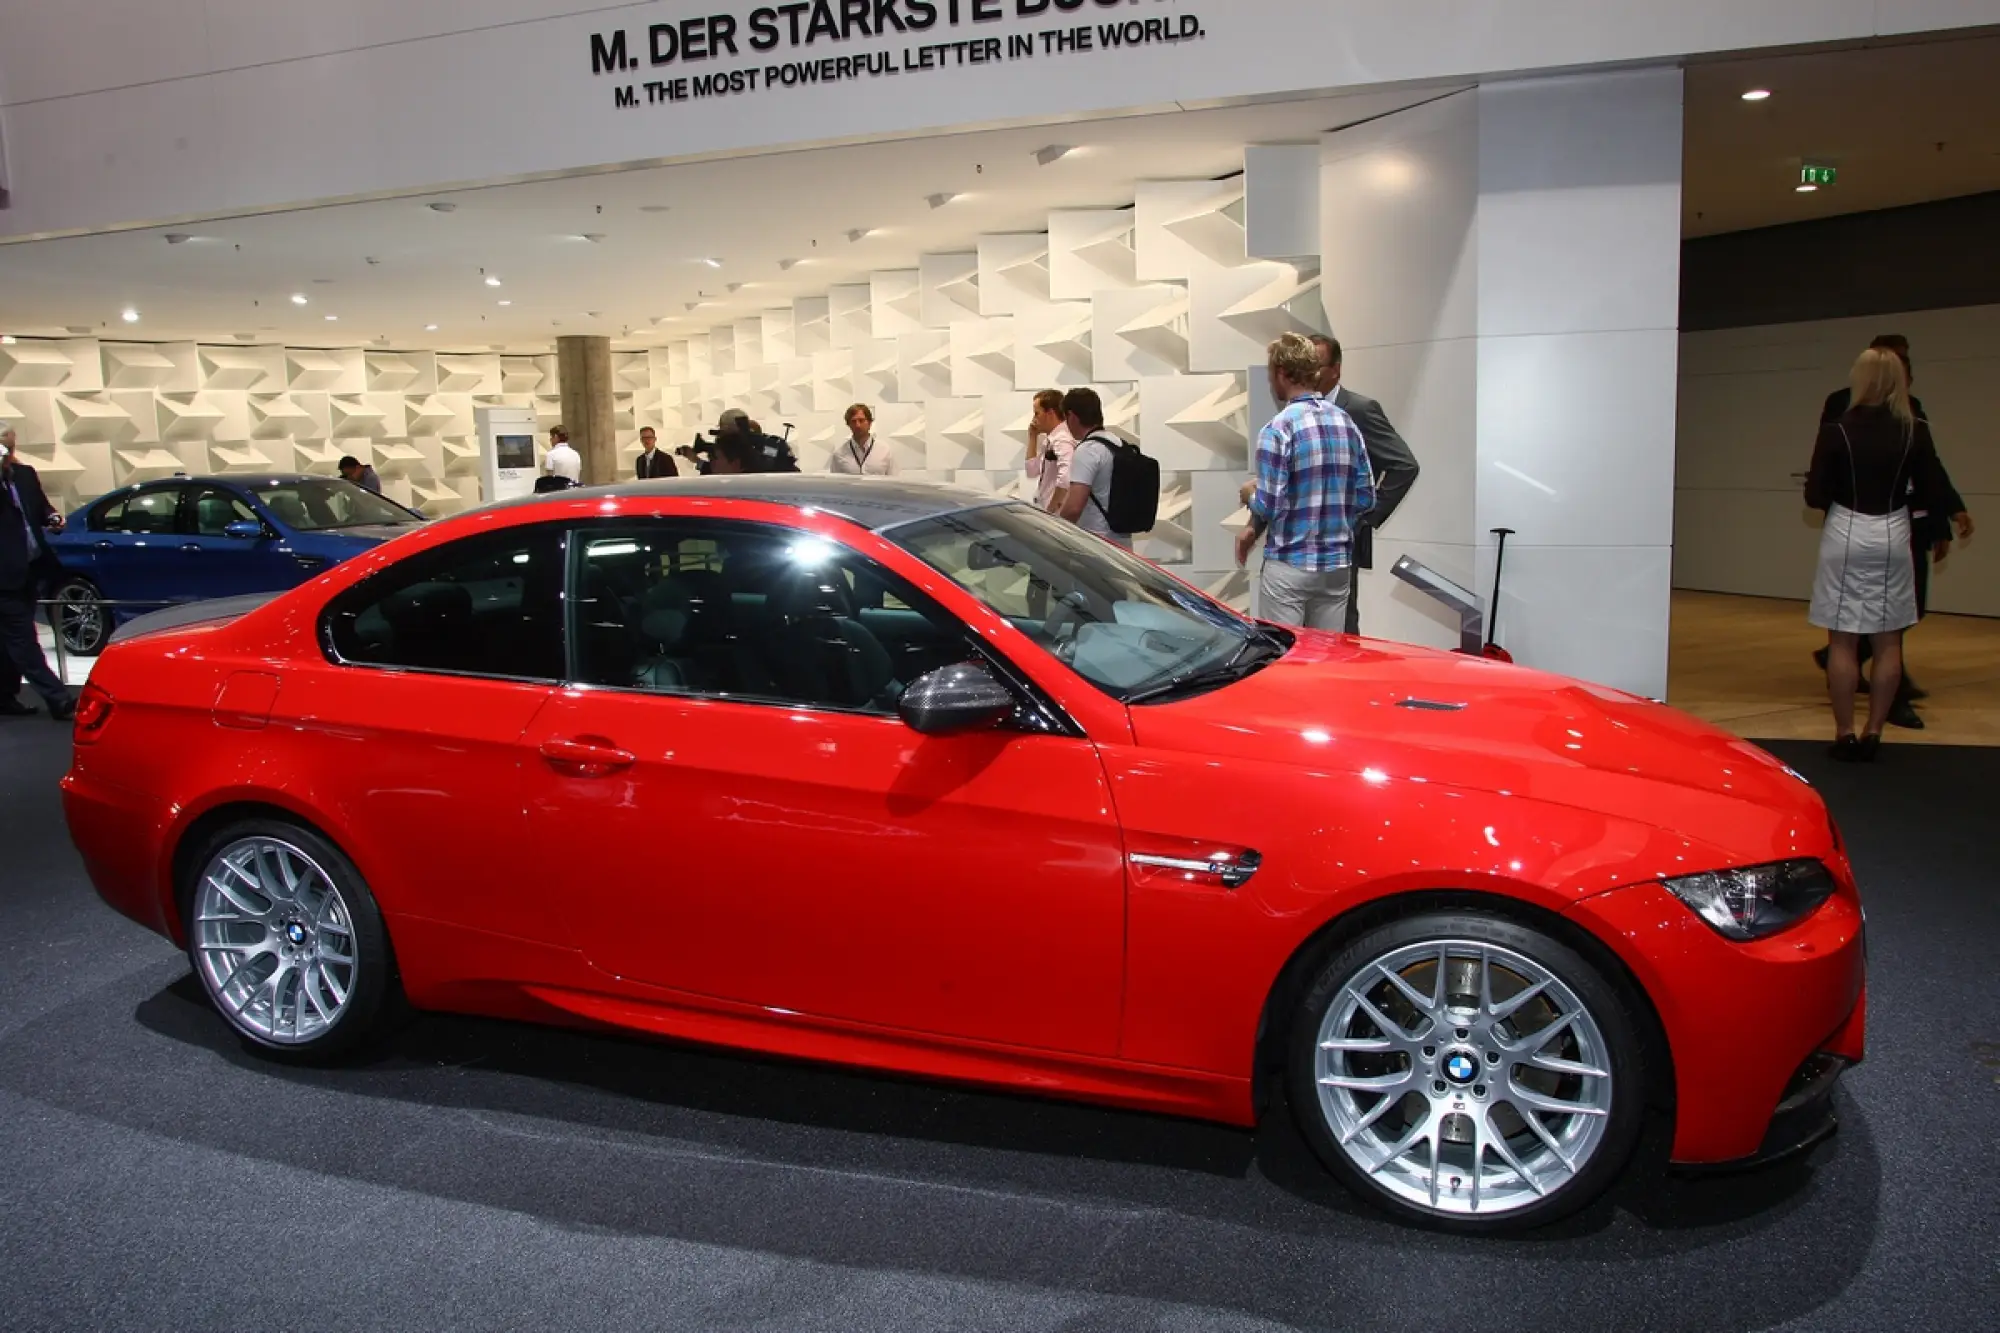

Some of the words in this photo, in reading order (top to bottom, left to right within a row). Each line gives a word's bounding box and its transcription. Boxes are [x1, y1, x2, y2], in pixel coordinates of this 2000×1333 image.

[590, 30, 638, 75] M.
[649, 14, 738, 67] DER
[614, 85, 640, 108] M.
[643, 78, 688, 104] THE
[693, 68, 760, 98] MOST
[765, 51, 899, 89] POWERFUL
[904, 38, 1002, 71] LETTER
[1008, 33, 1033, 58] IN
[1039, 26, 1092, 54] THE
[1098, 14, 1205, 47] WORLD.
